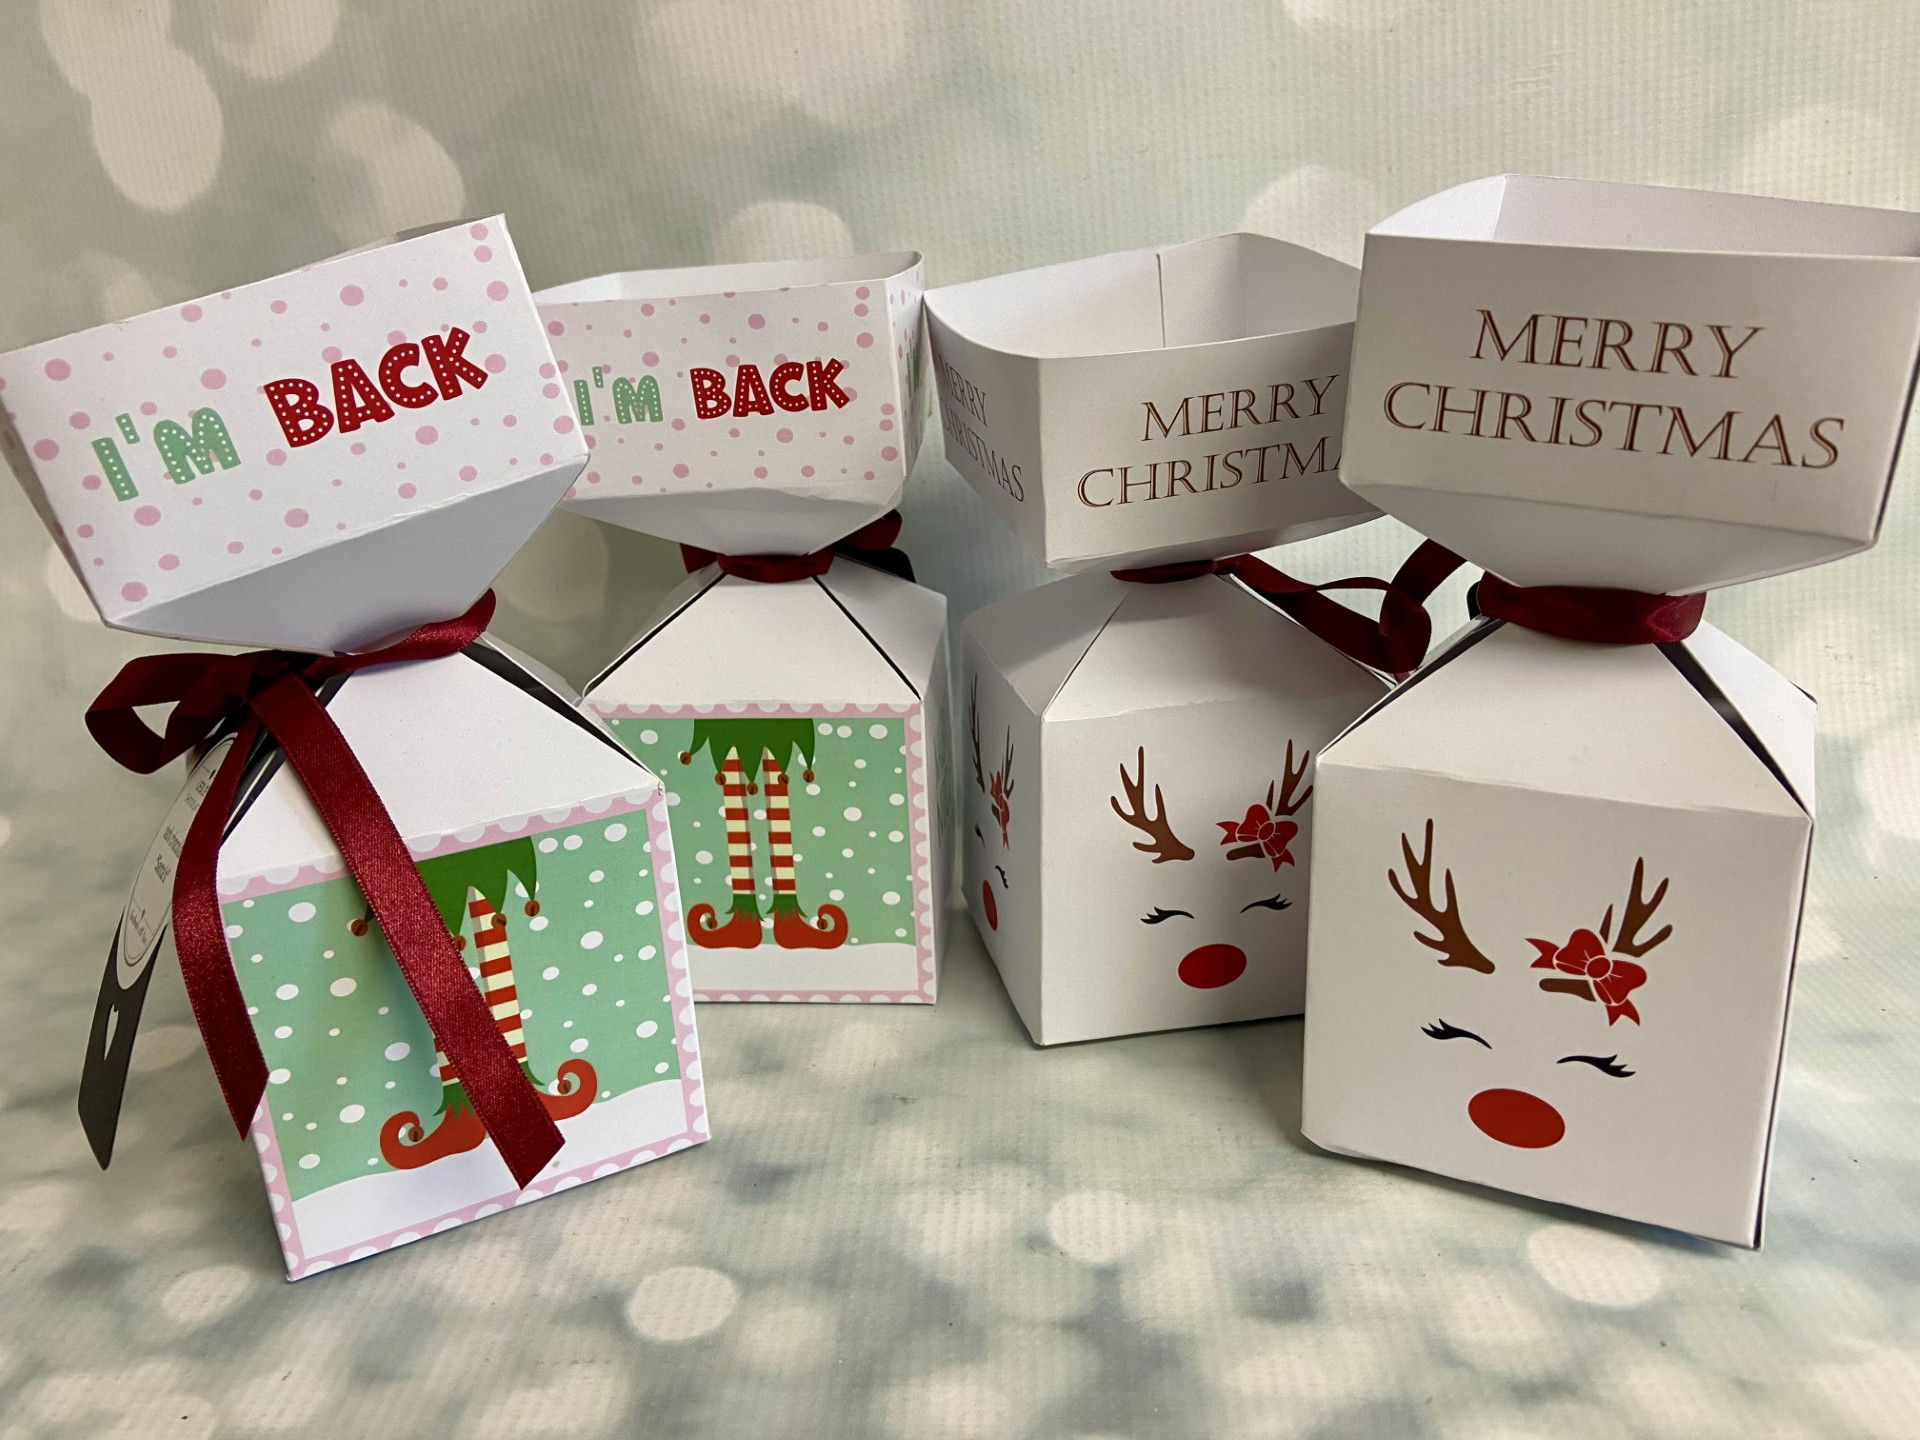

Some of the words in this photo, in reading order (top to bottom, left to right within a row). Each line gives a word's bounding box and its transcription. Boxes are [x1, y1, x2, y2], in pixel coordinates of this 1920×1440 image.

[1469, 309, 1766, 379] MERRY
[91, 407, 242, 502] I'M
[263, 326, 489, 448] BACK
[573, 366, 664, 426] I'M
[689, 357, 850, 420] BACK
[938, 353, 988, 427] MERRY
[1141, 374, 1340, 442] MERRY
[1383, 382, 1846, 469] CHRISTMAS
[1077, 435, 1343, 508] CHRISTM
